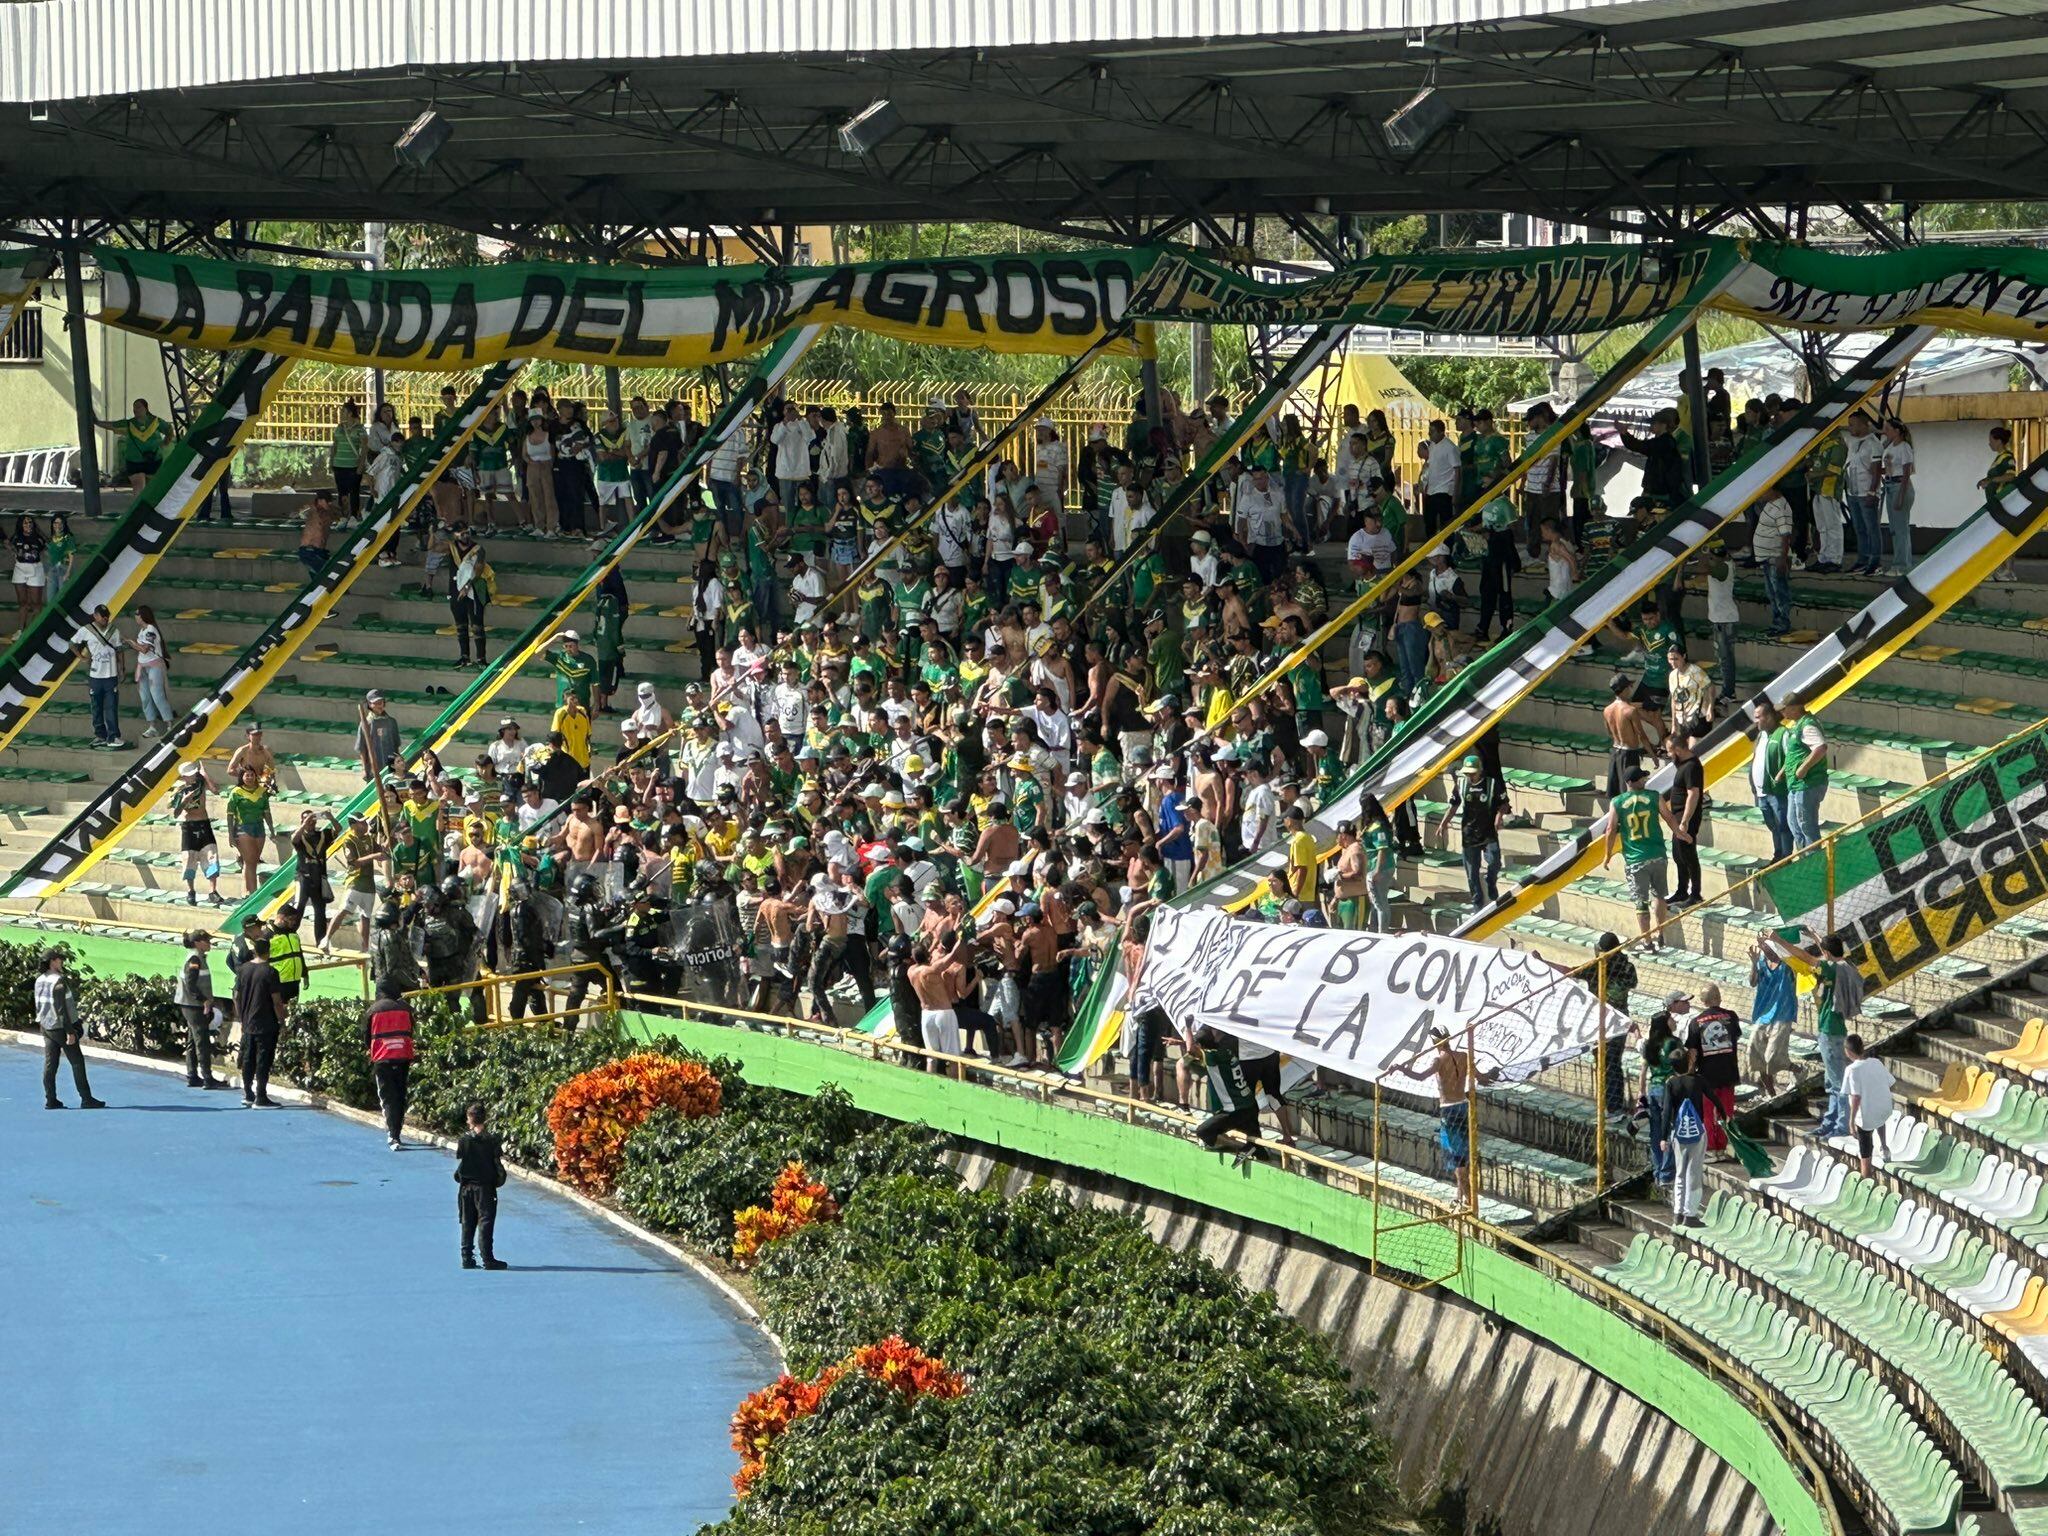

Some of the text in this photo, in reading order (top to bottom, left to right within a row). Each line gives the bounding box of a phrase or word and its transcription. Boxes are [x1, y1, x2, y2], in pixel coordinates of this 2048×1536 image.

[115, 256, 206, 339] LA
[228, 269, 478, 360] BANDA
[506, 274, 671, 359] DEL
[711, 260, 1136, 353] MILAGROSO
[1626, 810, 1651, 841] 27
[686, 946, 733, 966] POLICIA
[1252, 929, 1327, 969] LA
[1321, 936, 1381, 984] B
[1387, 941, 1478, 1012] CON
[1293, 983, 1370, 1060] LA
